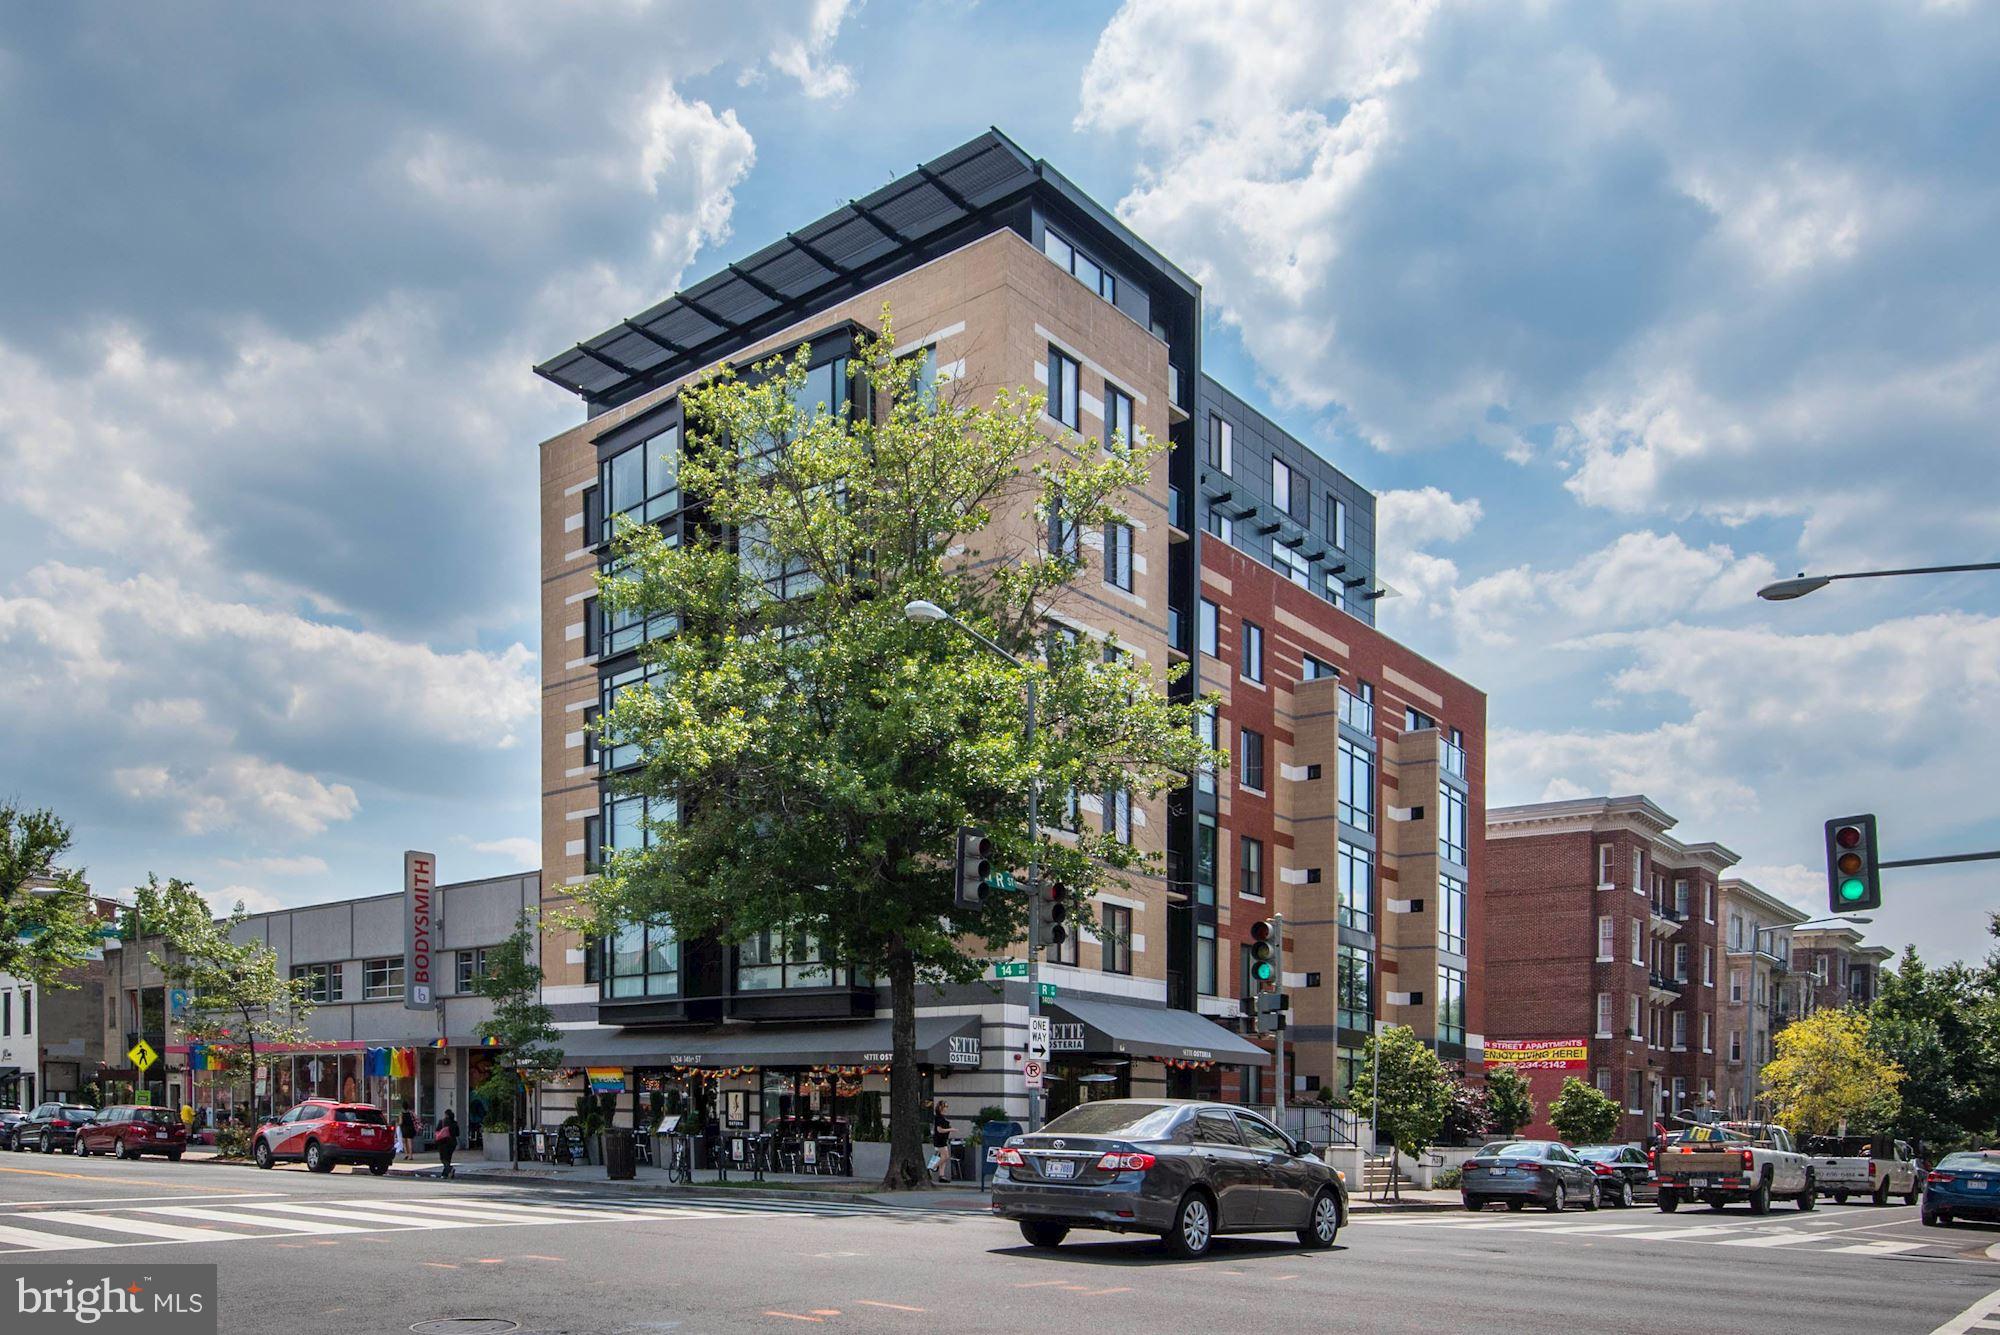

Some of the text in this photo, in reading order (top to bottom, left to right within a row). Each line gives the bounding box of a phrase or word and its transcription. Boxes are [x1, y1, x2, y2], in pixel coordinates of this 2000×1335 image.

[996, 872, 1004, 888] R
[414, 859, 429, 983] BODYSMITH
[1001, 965, 1012, 976] 14
[1041, 984, 1048, 995] R
[1032, 1020, 1047, 1030] ONE
[1032, 1031, 1047, 1042] WAY
[950, 1036, 980, 1053] SETTE
[1491, 1042, 1524, 1050] STREET
[1525, 1039, 1583, 1050] APARTMENTS
[950, 1053, 979, 1064] OSTERIA
[1483, 1049, 1583, 1060] ENJOY LIVING HERE!
